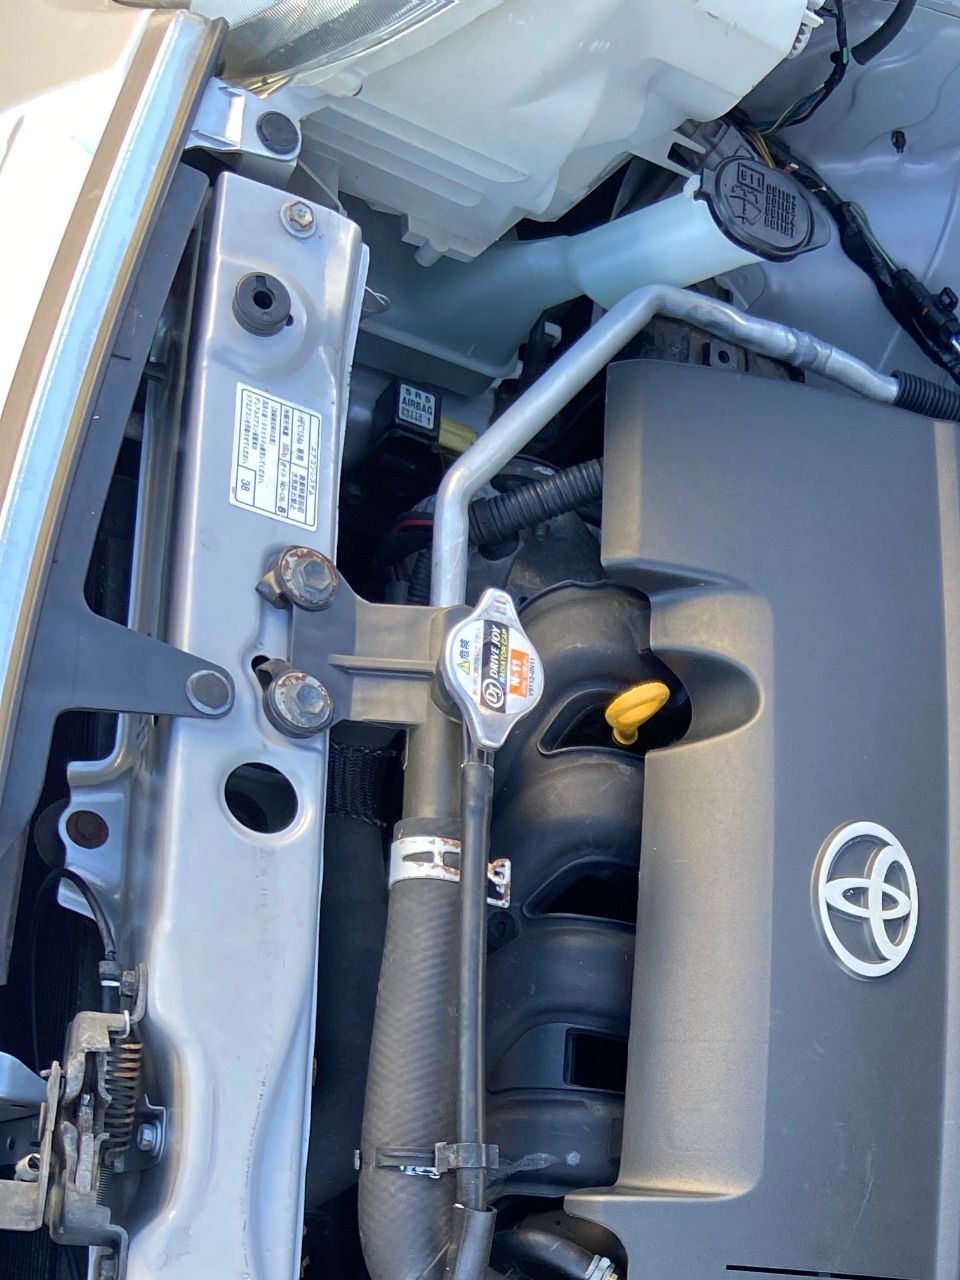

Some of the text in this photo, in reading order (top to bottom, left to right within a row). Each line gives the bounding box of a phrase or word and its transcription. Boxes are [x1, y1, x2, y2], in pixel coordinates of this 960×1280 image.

[402, 397, 432, 415] AIRBAG
[240, 479, 250, 491] 38
[459, 639, 470, 660] 危険
[491, 625, 501, 679] DRIVE JOY
[499, 646, 507, 683] RADIATOR
